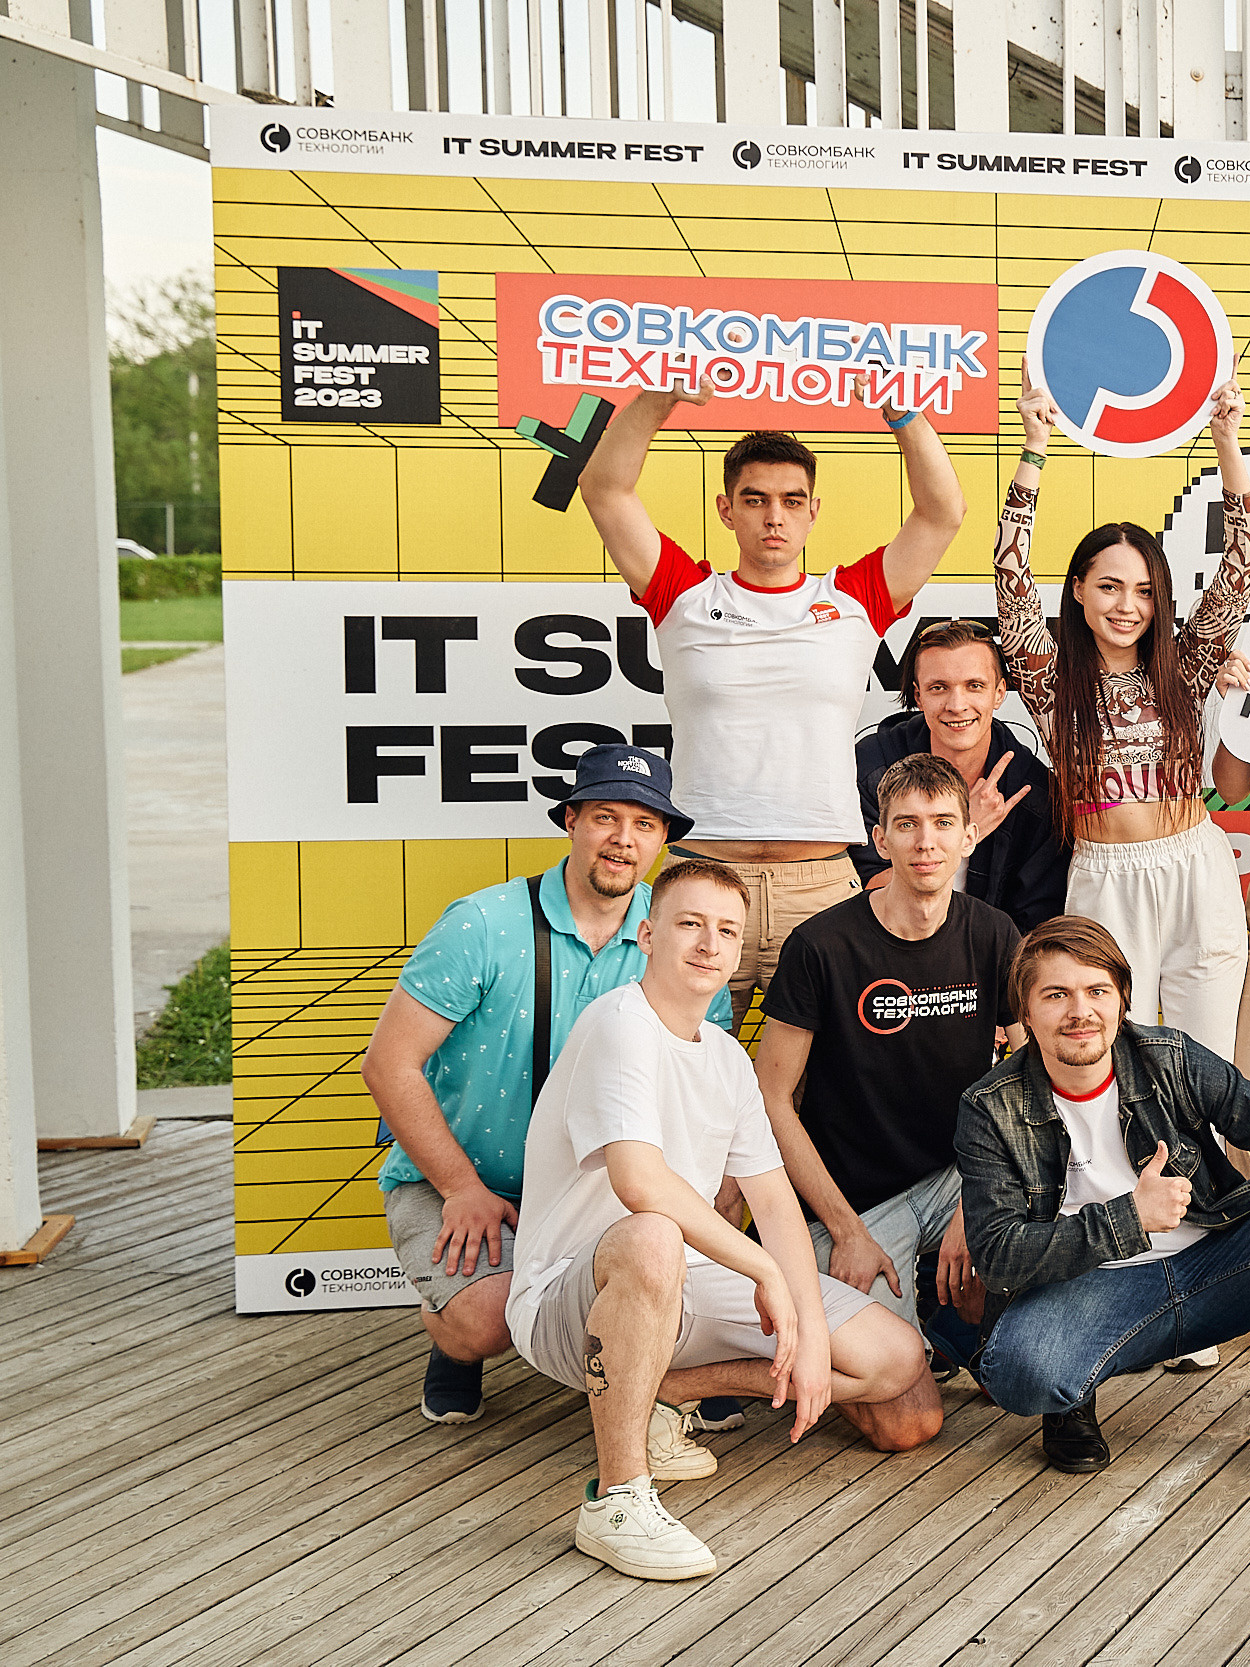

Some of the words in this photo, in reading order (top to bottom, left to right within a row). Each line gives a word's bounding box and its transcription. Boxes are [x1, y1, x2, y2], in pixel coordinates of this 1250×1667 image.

[296, 127, 413, 143] СОВКОМБАНК
[298, 142, 384, 154] ТЕХНОЛОГИИ
[443, 137, 472, 154] IT
[479, 138, 617, 160] SUMMER
[624, 144, 704, 162] FEST
[766, 144, 876, 159] СОВКОМБАНК
[767, 158, 848, 170] ТЕХНОЛОГИИ
[903, 152, 930, 169] IT
[937, 153, 1066, 174] SUMMER
[1073, 158, 1148, 177] FEST
[544, 299, 982, 372] СОВКОМБАНК
[292, 342, 430, 365] SUMMER
[293, 365, 376, 385] FEST
[542, 341, 951, 413] ТЕХНОЛОГИИ
[294, 387, 383, 409] 2023
[344, 615, 478, 694] IT
[872, 988, 978, 1008] СОВКОМБАНК
[872, 1000, 977, 1019] ТЕХНОЛОГИИ
[321, 1266, 405, 1281] СОВКОМБ
[322, 1281, 406, 1293] ТЕХНОЛОГИИ
